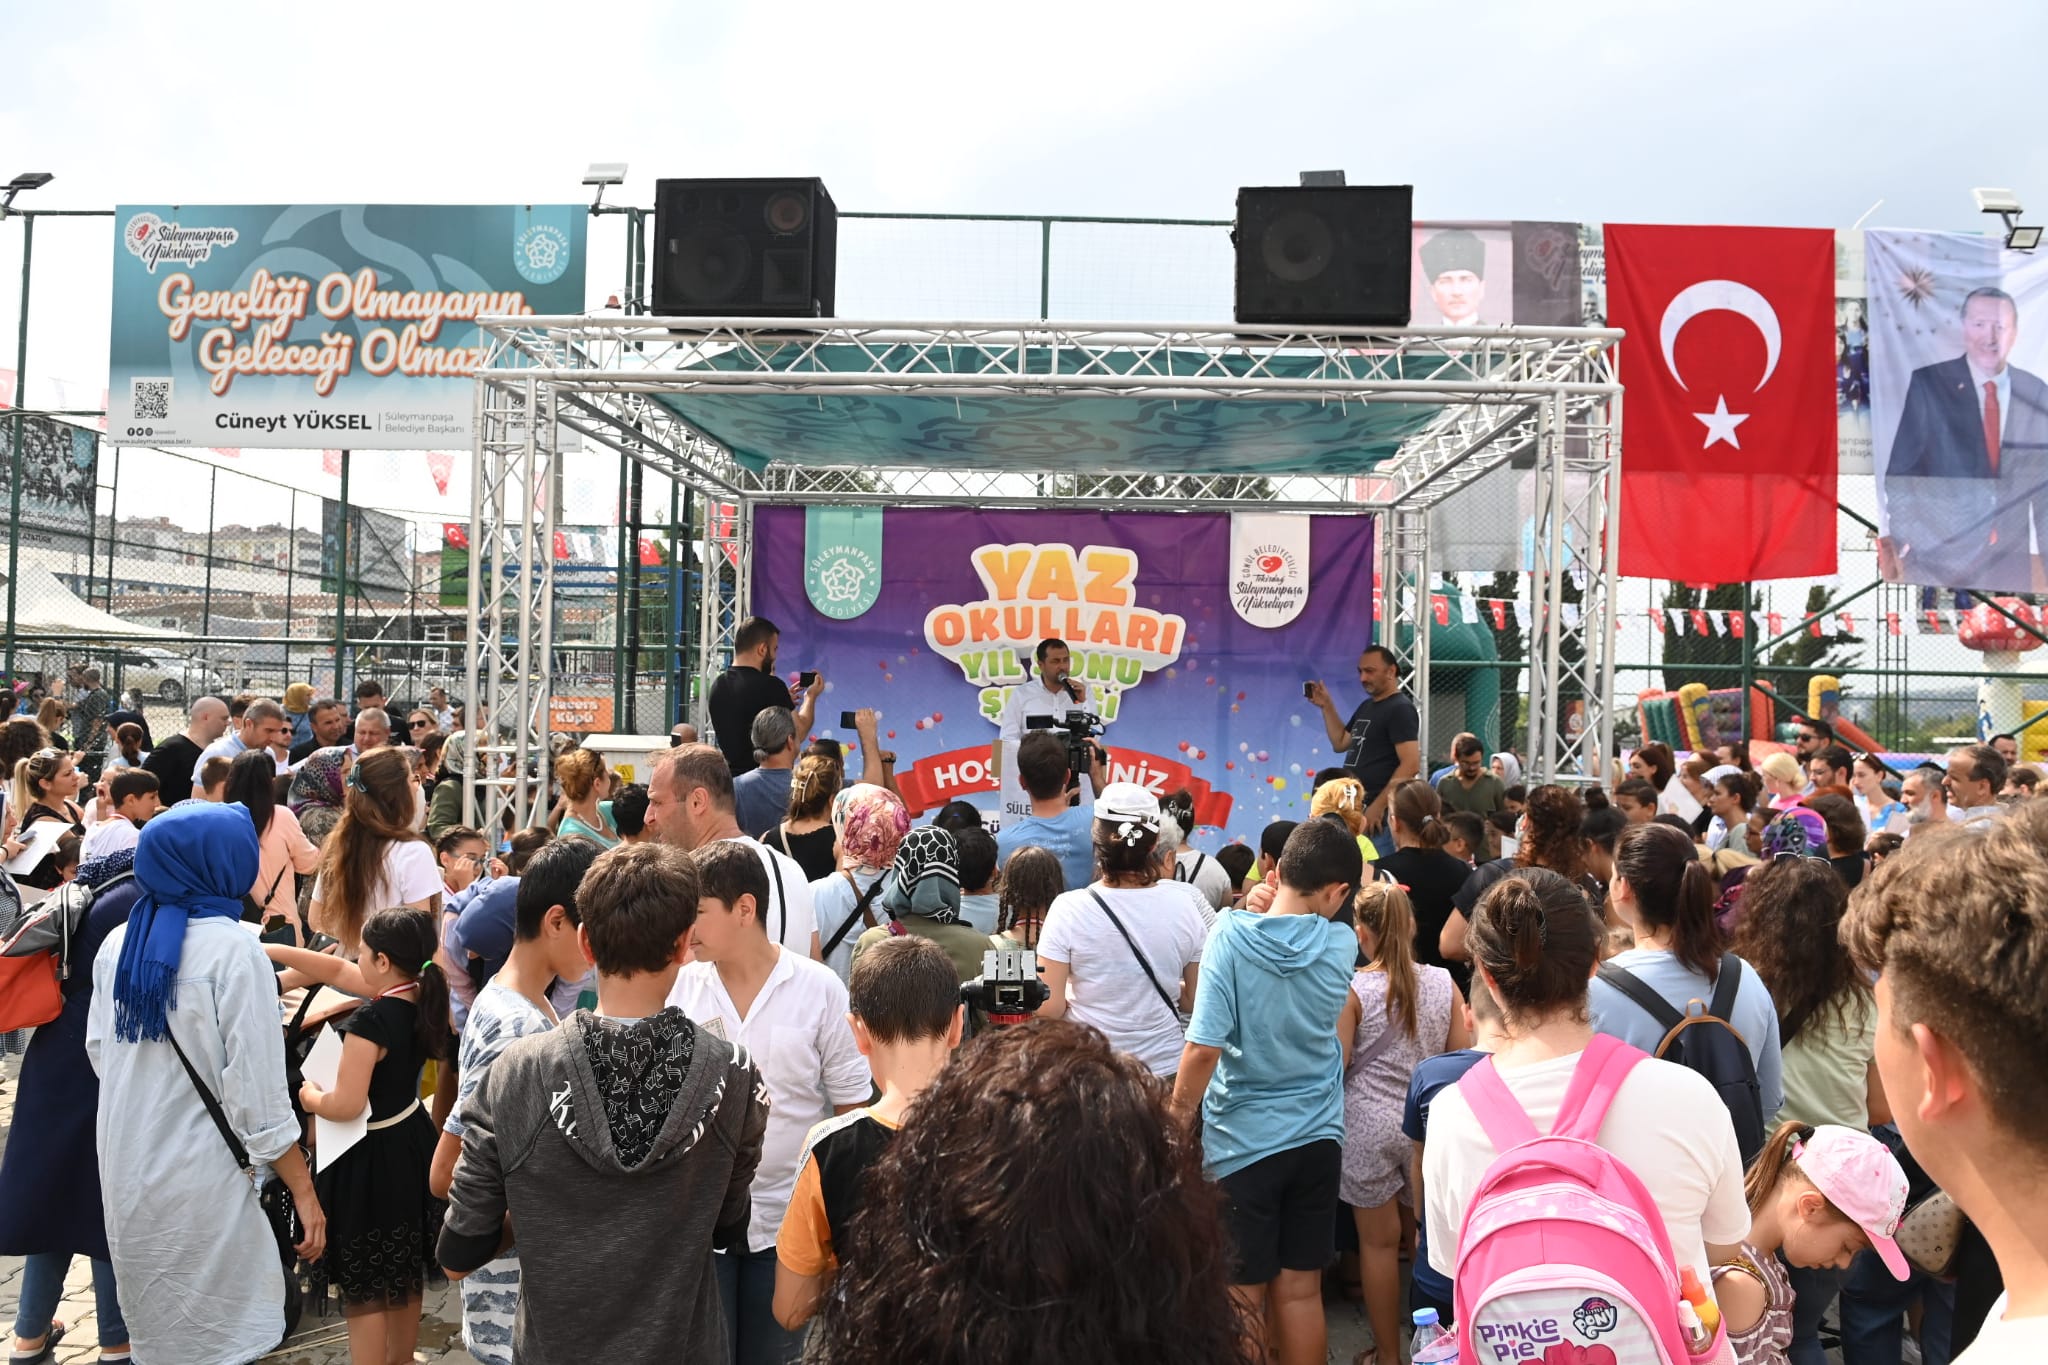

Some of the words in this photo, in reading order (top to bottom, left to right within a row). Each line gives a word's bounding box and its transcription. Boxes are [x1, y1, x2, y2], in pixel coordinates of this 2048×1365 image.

[156, 225, 234, 247] Süleymanpaşa
[142, 242, 208, 270] Yükseliyor
[158, 268, 311, 342] Gençliği
[199, 323, 354, 395] Geleceği
[215, 411, 287, 432] Cüneyt
[293, 410, 372, 430] YÜKSEL
[385, 412, 454, 424] Süleymanpaşa
[385, 424, 425, 434] Belediye
[428, 424, 465, 434] Başkanı
[810, 545, 877, 574] SÜLEYMANPAŞA
[980, 550, 1130, 606] YAZ
[1235, 581, 1303, 598] Süleymanpaşa
[811, 592, 874, 617] BELEDİYESİ
[1237, 596, 1295, 615] Yükseliyor
[933, 606, 1178, 655] OKULLARI
[959, 650, 1022, 679] YIL
[1477, 1319, 1560, 1343] Pinkie
[1573, 1307, 1617, 1339] PONY
[1493, 1340, 1535, 1362] Pie
